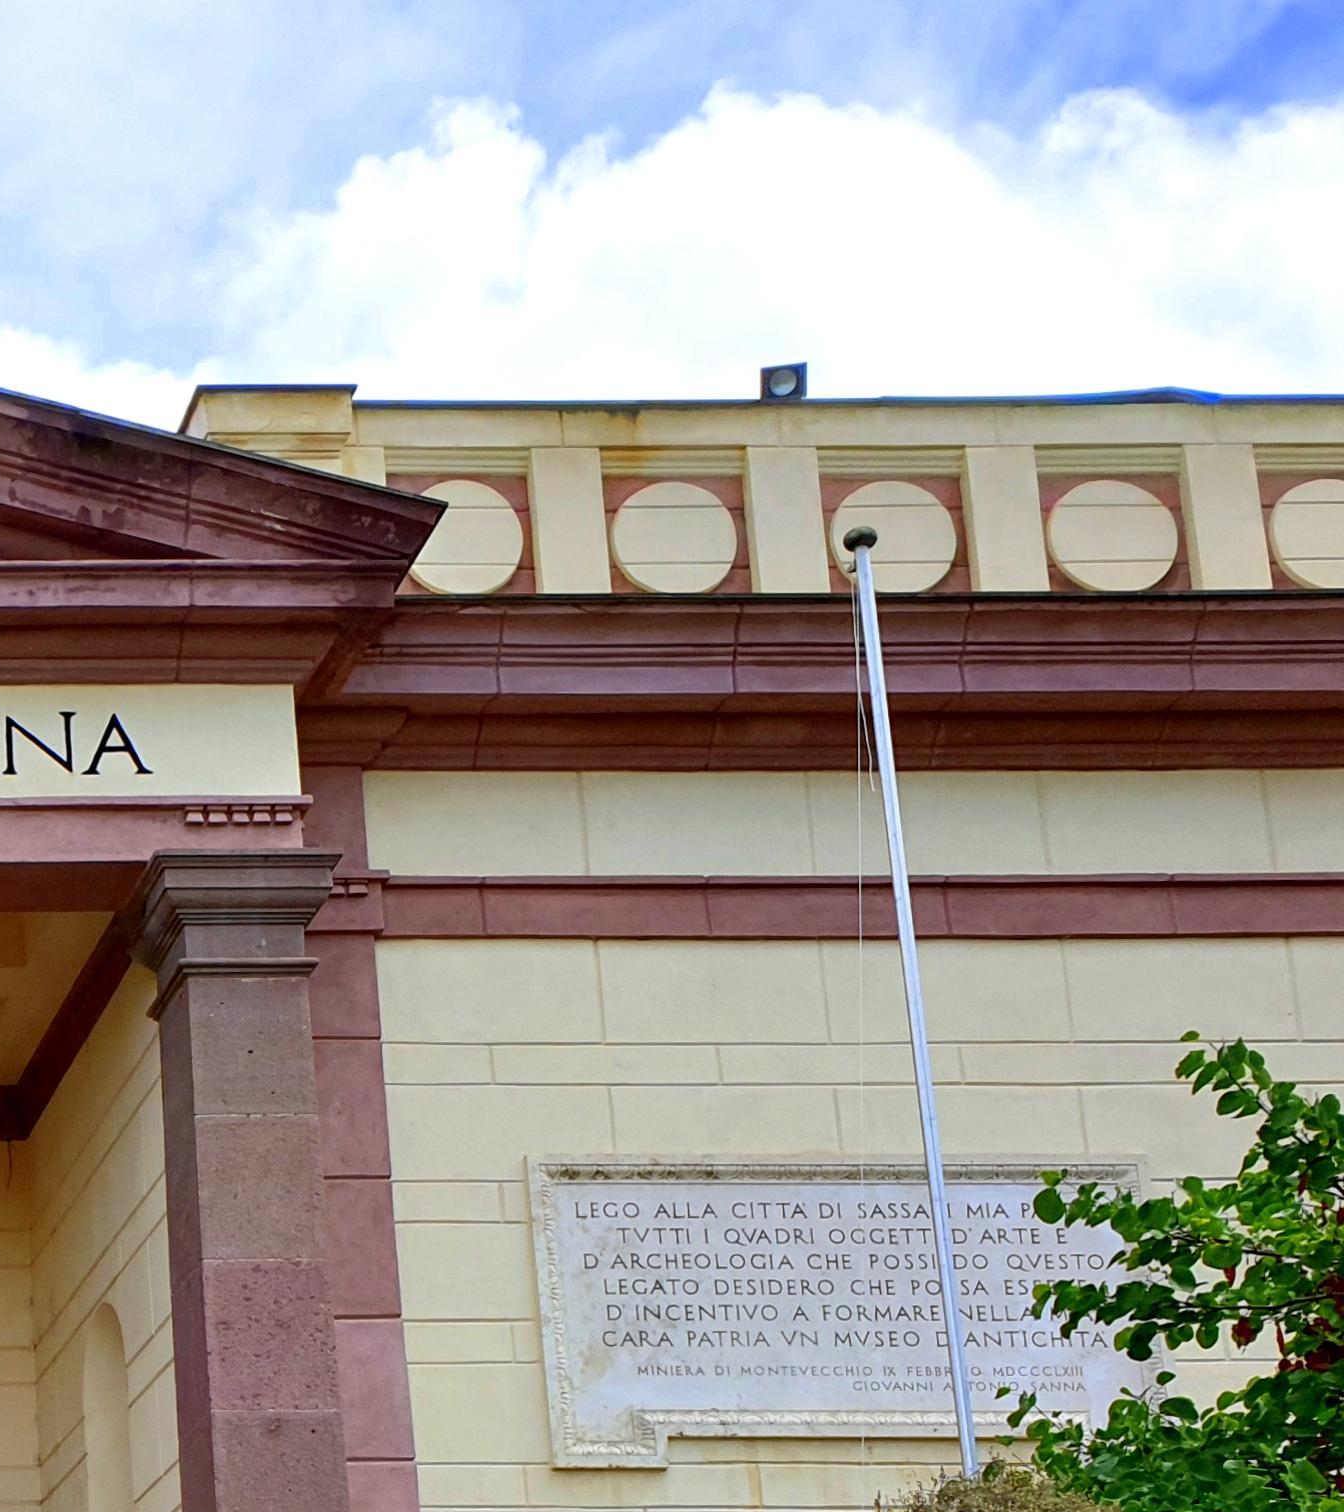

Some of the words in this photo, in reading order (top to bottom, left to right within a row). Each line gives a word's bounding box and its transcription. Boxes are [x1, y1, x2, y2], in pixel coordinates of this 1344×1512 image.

[574, 1202, 641, 1220] LEGO
[653, 1202, 719, 1220] ALLA
[818, 1202, 842, 1220] DI
[857, 1202, 952, 1220] SASSAI
[966, 1202, 1010, 1220] MIA
[616, 1227, 691, 1245] TVTTI
[703, 1227, 710, 1245] I
[723, 1227, 816, 1247] QVADRI
[828, 1227, 938, 1245] OGGETT
[1056, 1227, 1068, 1245] E
[806, 1252, 853, 1270] CHE
[869, 1252, 989, 1270] POSSIDO
[1006, 1252, 1105, 1272] QVESTO
[603, 1278, 700, 1296] LEGATO
[714, 1278, 835, 1296] DESIDERO
[850, 1278, 896, 1296] CHE
[911, 1278, 990, 1296] POSA
[792, 1304, 810, 1322] A
[822, 1304, 942, 1322] FORMARE
[601, 1329, 674, 1348] CARA
[687, 1329, 771, 1348] PATRIA
[780, 1329, 819, 1348] VN
[834, 1329, 921, 1348] MVSEO
[637, 1365, 705, 1377] MINIERA
[714, 1365, 731, 1377] DI
[740, 1365, 873, 1377] MONTEVECCHIO
[883, 1365, 897, 1377] IX
[906, 1365, 982, 1377] FEBBRIO
[853, 1380, 934, 1392] GIOVANNI
[942, 1380, 1020, 1392] ATONIO
[1030, 1380, 1087, 1392] SANNA
